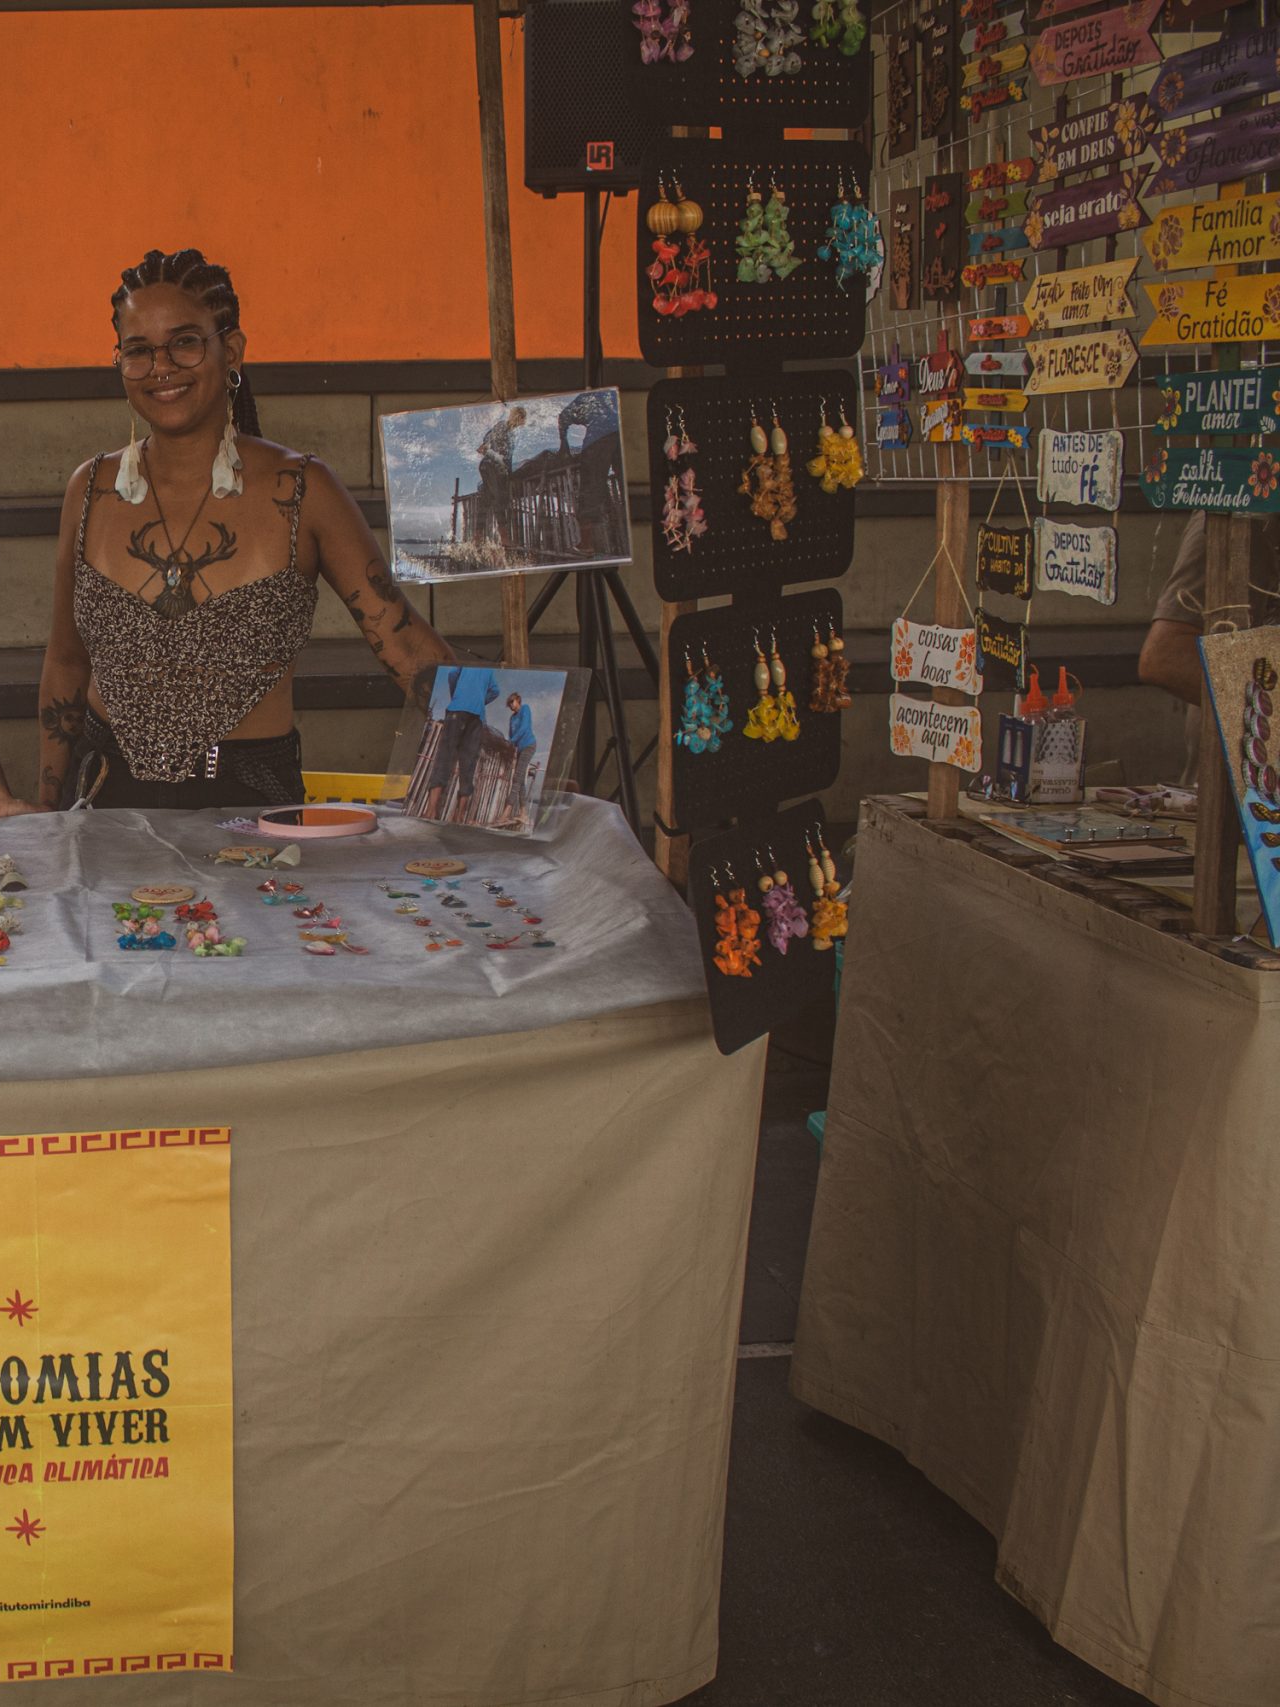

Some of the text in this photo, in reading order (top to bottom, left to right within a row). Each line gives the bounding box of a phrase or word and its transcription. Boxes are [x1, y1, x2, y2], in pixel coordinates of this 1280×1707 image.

[1055, 21, 1102, 51] DEPOIS
[1246, 28, 1278, 59] COM
[1063, 33, 1141, 77] Gratidão
[1061, 110, 1109, 144] CONFIE
[1057, 135, 1116, 172] EM DEUS
[1043, 191, 1121, 230] seja grato
[1192, 199, 1263, 233] Família
[1208, 235, 1265, 262] Amor
[1205, 280, 1228, 307] Fé
[1061, 303, 1090, 321] amor
[1177, 310, 1264, 341] Gratidão
[919, 357, 946, 395] Deus
[1048, 342, 1100, 379] FLORESCE
[1201, 412, 1241, 430] amor
[1052, 435, 1104, 453] ANTES DE
[1052, 454, 1100, 503] tudo FÉ
[1178, 449, 1224, 482] colhi
[1172, 483, 1251, 508] Felicidade
[987, 532, 1020, 556] CULTIVE
[1054, 532, 1091, 552] DEPOIS
[1014, 560, 1024, 576] DA
[1045, 550, 1105, 589] Gratidão
[918, 627, 958, 653] coisas
[921, 651, 951, 684] boas
[896, 704, 969, 736] acontecem
[921, 729, 950, 759] aqui
[49, 1408, 170, 1447] VIVER
[44, 1453, 170, 1482] CLIMÁTICA
